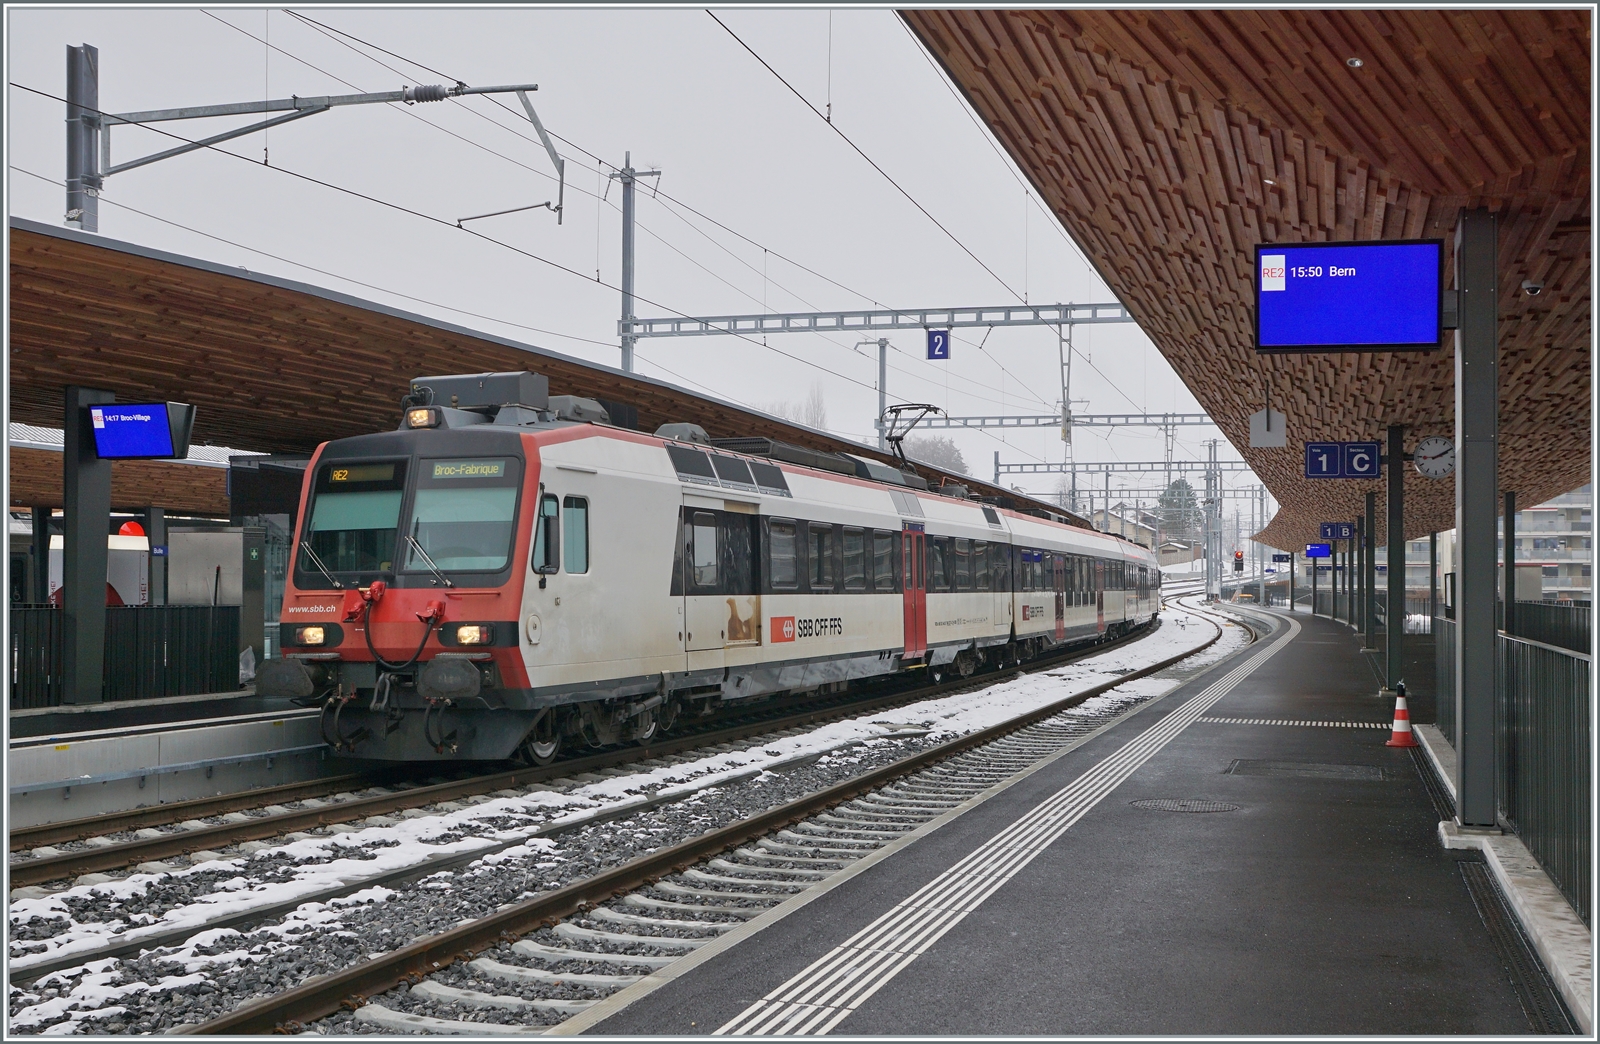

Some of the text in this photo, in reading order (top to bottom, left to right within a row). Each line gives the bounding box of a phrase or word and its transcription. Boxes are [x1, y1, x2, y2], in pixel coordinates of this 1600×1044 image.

[1262, 266, 1356, 278] RE2 15:50 Bern
[934, 335, 943, 355] 2
[120, 414, 151, 422] Broc-Village
[1318, 453, 1327, 472] 1
[1352, 453, 1370, 472] C
[332, 469, 349, 481] RE2
[434, 463, 499, 476] Broc-Fabrique
[1326, 527, 1331, 537] 1
[1342, 527, 1350, 537] B
[288, 604, 336, 613] www.sbb.ch
[797, 617, 843, 638] SBB CFF FFS
